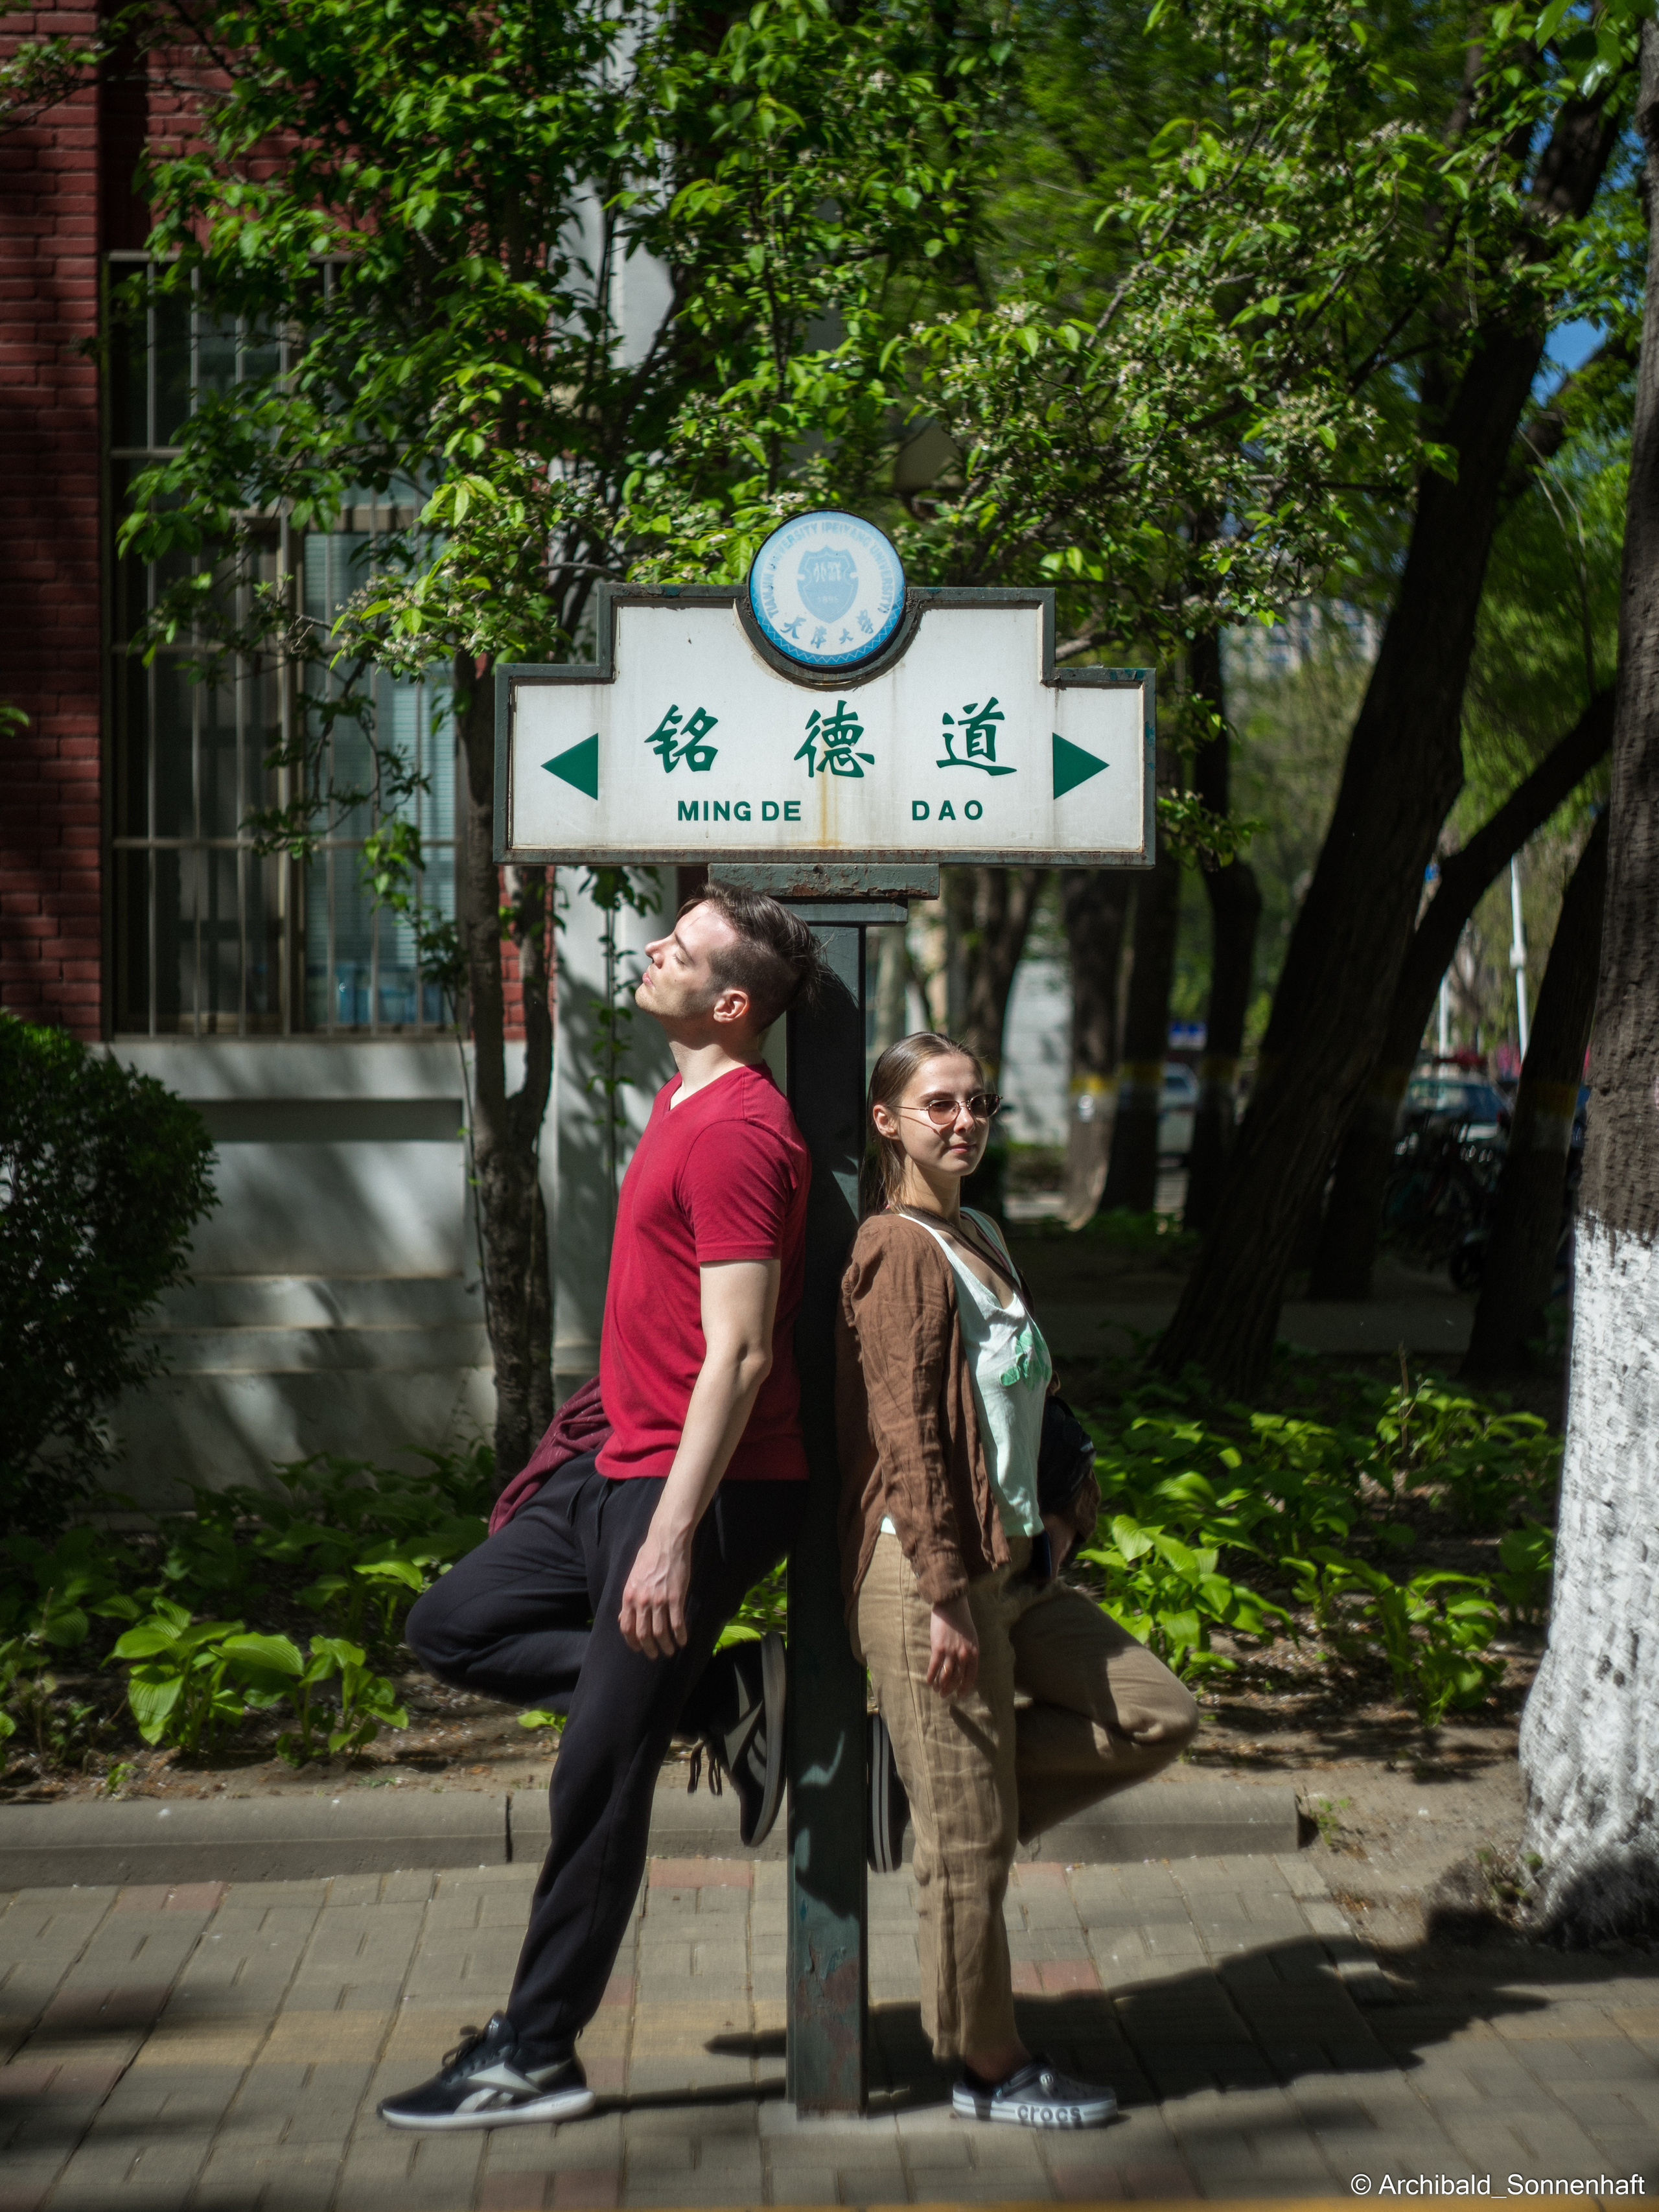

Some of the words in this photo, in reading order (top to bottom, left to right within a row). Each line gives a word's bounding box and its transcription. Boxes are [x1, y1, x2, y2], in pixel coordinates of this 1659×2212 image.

[644, 696, 1017, 778] 铭德道
[677, 800, 752, 822] MING
[761, 800, 802, 822] DE
[911, 800, 984, 822] DAO
[1017, 2104, 1082, 2122] crocs
